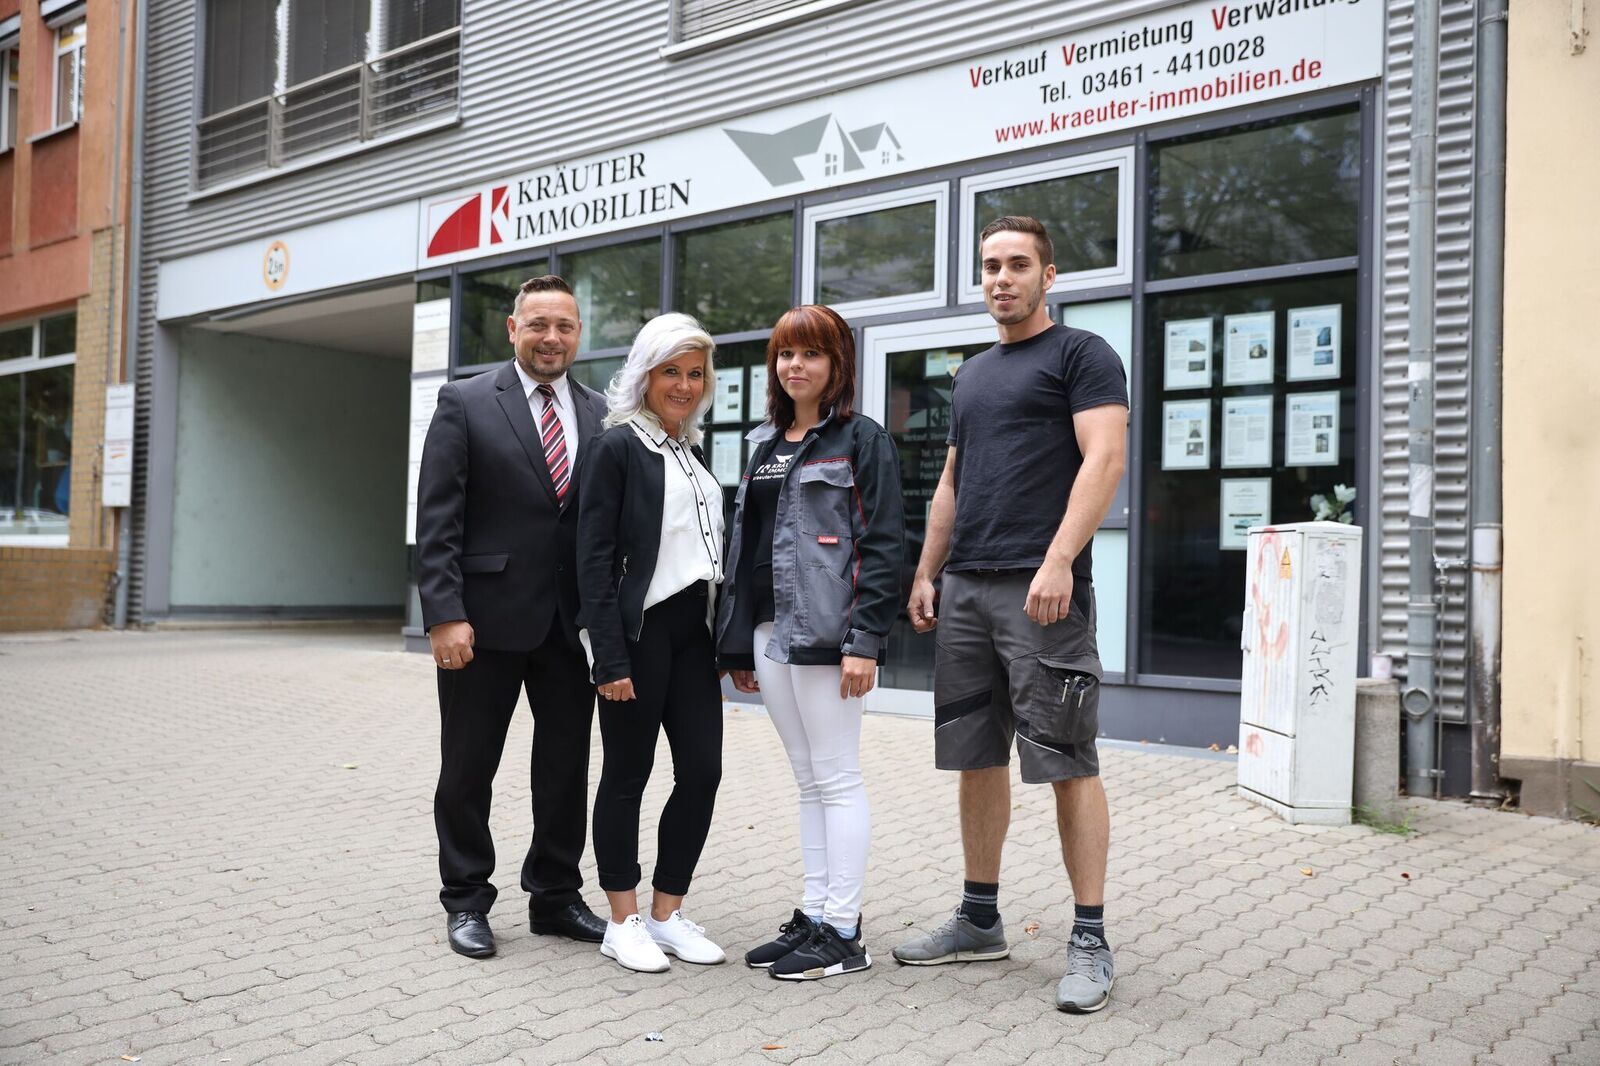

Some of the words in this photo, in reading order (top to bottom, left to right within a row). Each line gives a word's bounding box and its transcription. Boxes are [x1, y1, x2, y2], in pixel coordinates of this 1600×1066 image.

[969, 51, 1048, 88] Verkauf
[1062, 19, 1193, 66] Vermietung
[1211, 0, 1360, 31] Verwa
[1039, 72, 1072, 104] Tel.
[1082, 65, 1143, 95] 03461
[1167, 35, 1265, 77] 4410028
[995, 59, 1322, 144] www.kraeuter-immobilien.de
[515, 179, 692, 241] IMMOBILIEN
[517, 151, 646, 205] KRÄUTER
